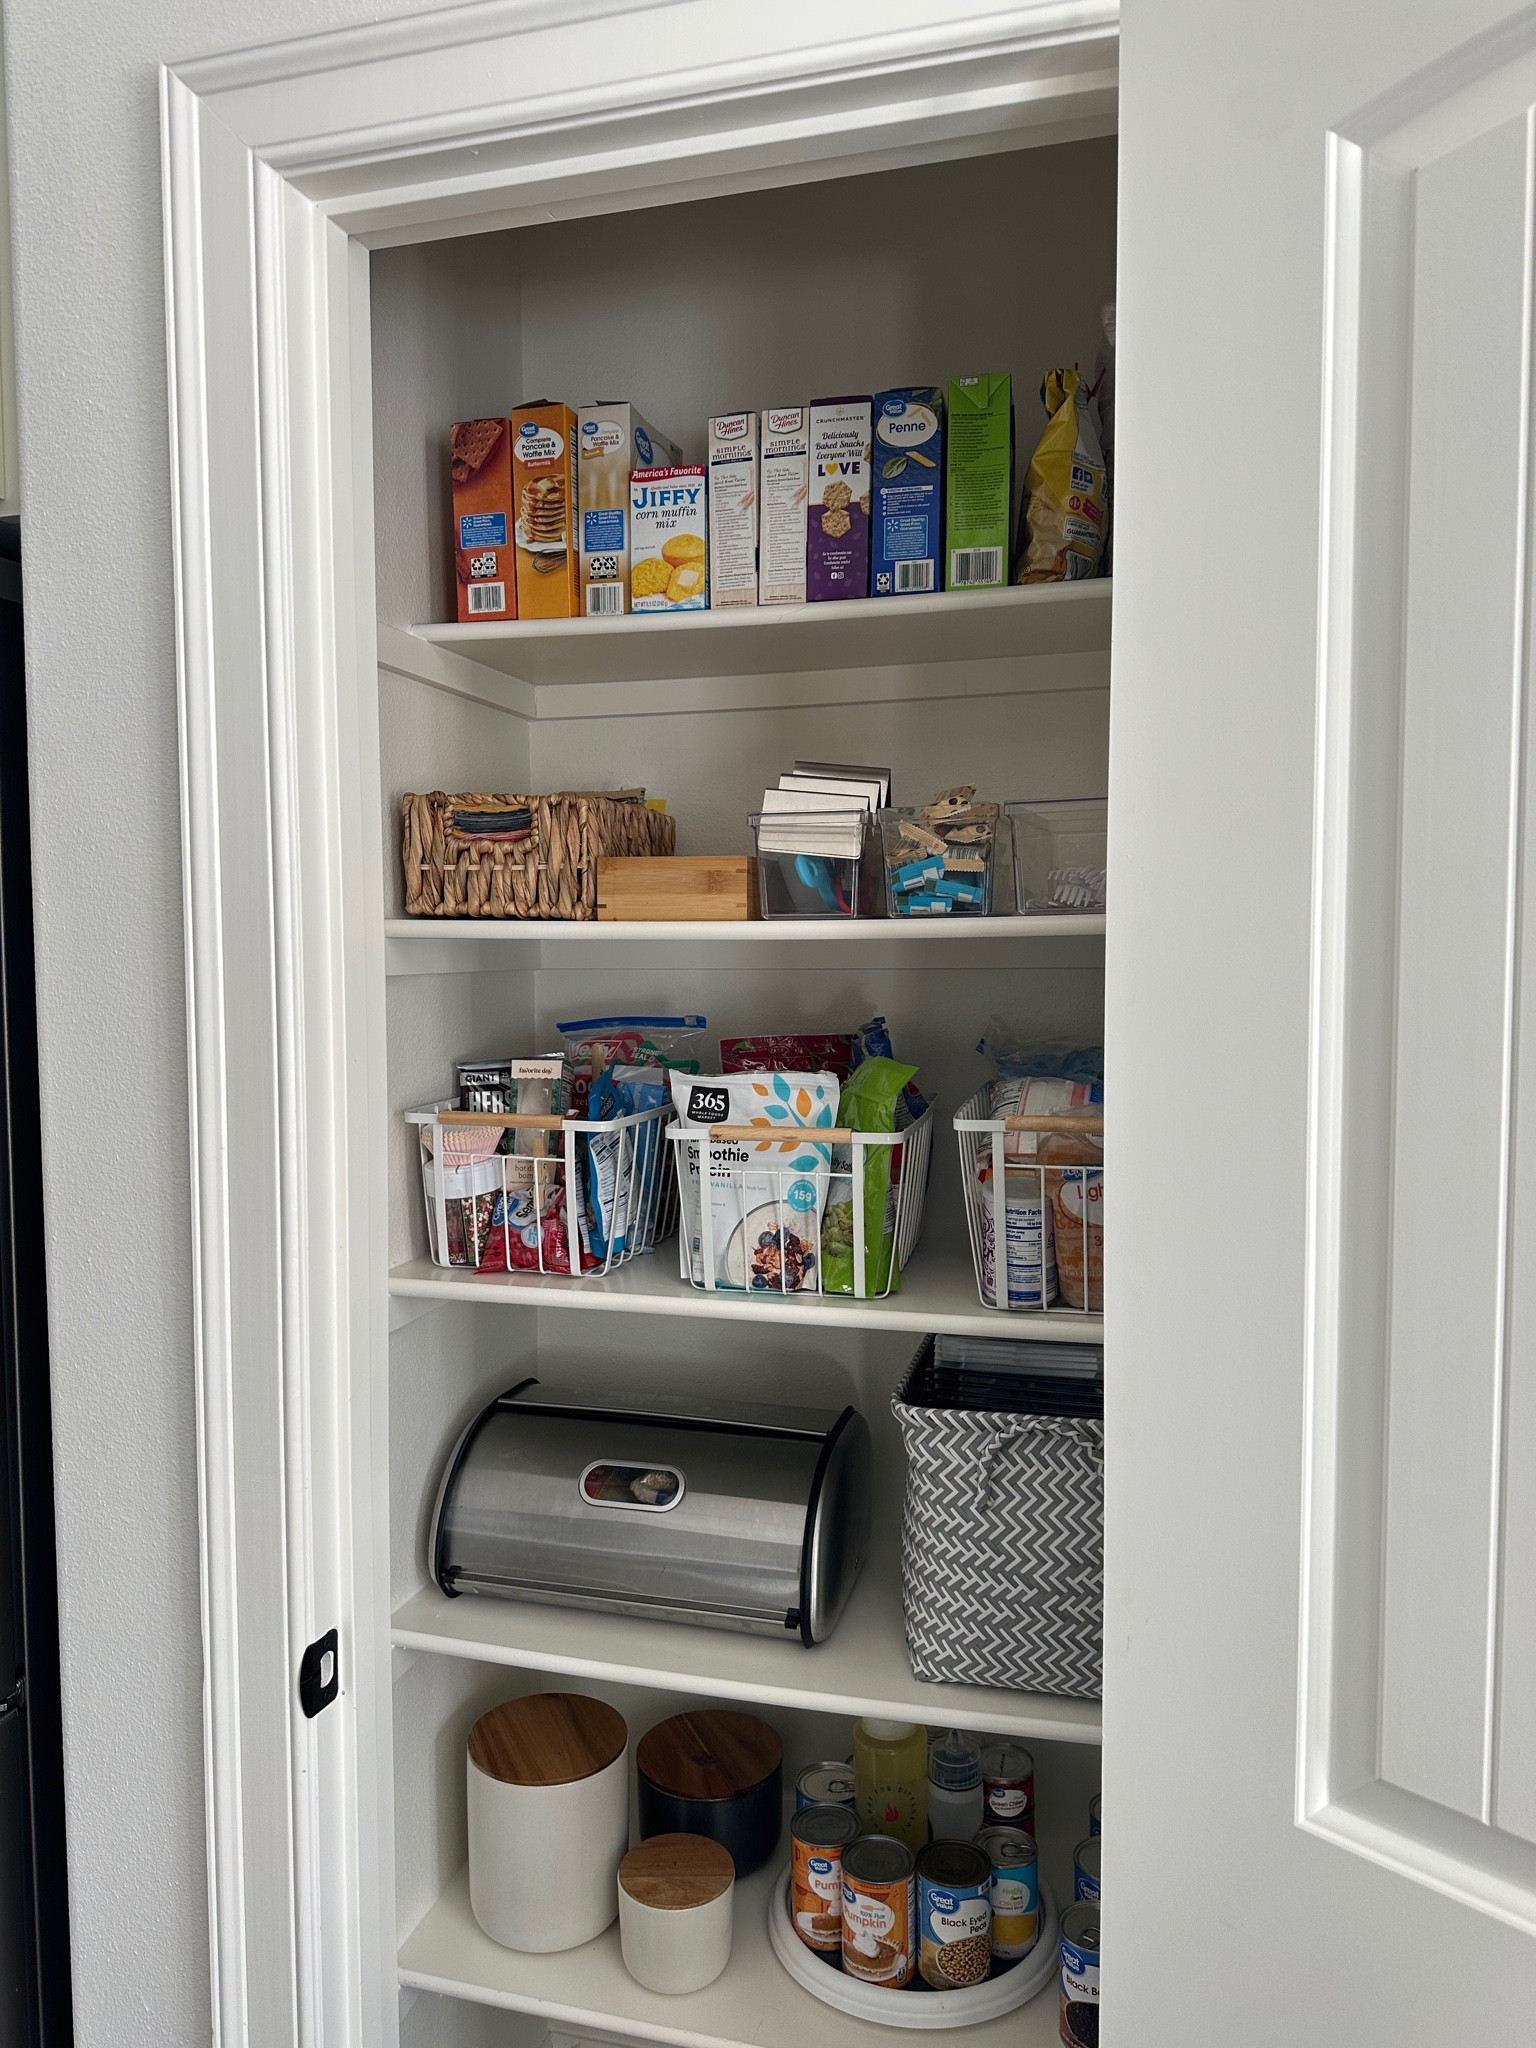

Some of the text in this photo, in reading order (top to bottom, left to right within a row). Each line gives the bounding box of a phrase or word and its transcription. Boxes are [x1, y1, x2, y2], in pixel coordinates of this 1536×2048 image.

[771, 412, 799, 423] Duncan
[816, 416, 864, 424] CRUNCHMASTER
[717, 418, 745, 430] Duncan
[775, 419, 798, 430] Hines
[889, 422, 926, 433] Penne
[721, 426, 743, 436] Hines
[822, 430, 859, 440] Deliciously
[522, 443, 550, 451] Pancake
[815, 440, 864, 450] Baked Snacks
[816, 449, 862, 460] Everyone Will
[631, 465, 701, 479] America's Favorite
[635, 506, 697, 520] corn muffin
[655, 518, 677, 529] mix
[630, 1053, 648, 1061] SEAL
[632, 1047, 661, 1057] STRONG
[541, 1067, 553, 1075] day
[465, 1073, 496, 1083] GIANT
[692, 1092, 726, 1111] 365
[687, 1146, 749, 1162] Smothie
[514, 1164, 527, 1172] hot
[690, 1162, 730, 1178] Prein
[710, 1182, 743, 1190] VANILLA
[793, 1190, 812, 1202] 15g
[810, 1859, 828, 1868] Great
[930, 1892, 954, 1906] Great
[936, 1901, 954, 1911] Value
[941, 1910, 987, 1927] Black Eyed
[970, 1921, 987, 1935] Peas
[1066, 1974, 1089, 1993] Black
